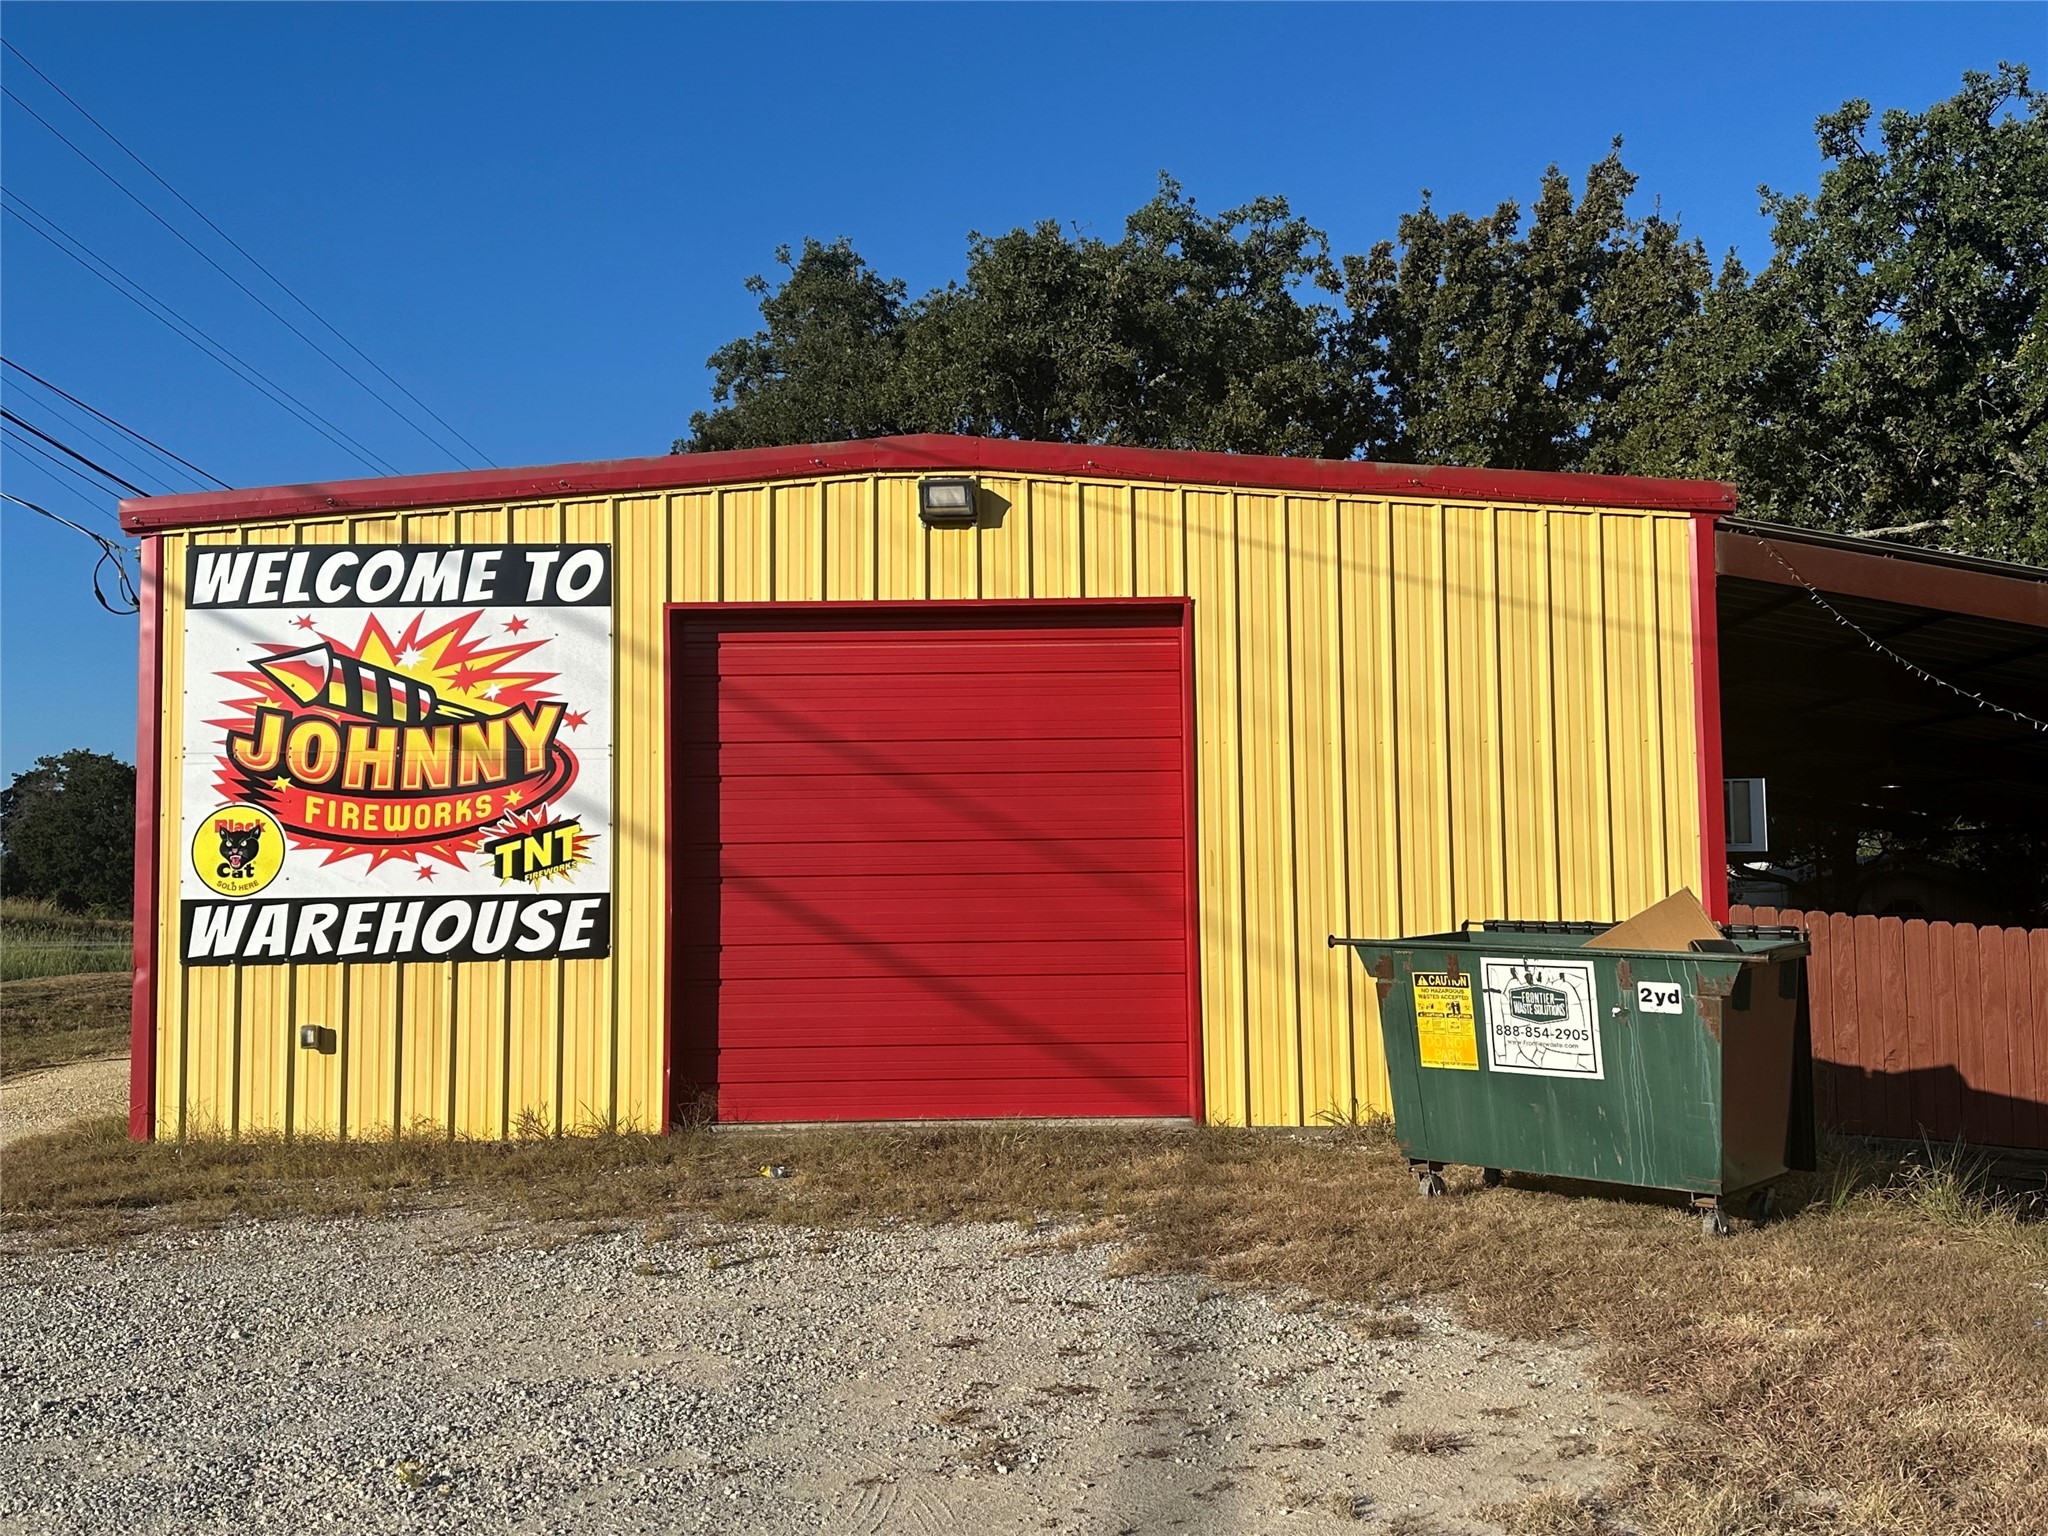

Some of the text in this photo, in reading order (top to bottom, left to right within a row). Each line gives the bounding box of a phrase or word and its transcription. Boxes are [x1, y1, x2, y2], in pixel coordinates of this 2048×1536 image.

[192, 549, 605, 604] WELCOME TO
[231, 702, 563, 791] JOHNNY
[304, 795, 493, 832] FIREWORKS
[214, 819, 266, 833] Black
[495, 823, 580, 879] TNT
[216, 862, 255, 878] Cat
[524, 860, 578, 881] FIREWORKS
[216, 880, 259, 891] SOLD HERE
[187, 898, 601, 959] WAREHOUSE
[1521, 991, 1555, 1005] FRONTIER
[1639, 988, 1680, 1006] 2yd
[1512, 1001, 1566, 1017] WASTE SOLUTIONS
[1496, 1024, 1589, 1041] 888-854-2905
[1427, 1036, 1468, 1048] DO NOT
[1435, 1048, 1462, 1061] PARK
